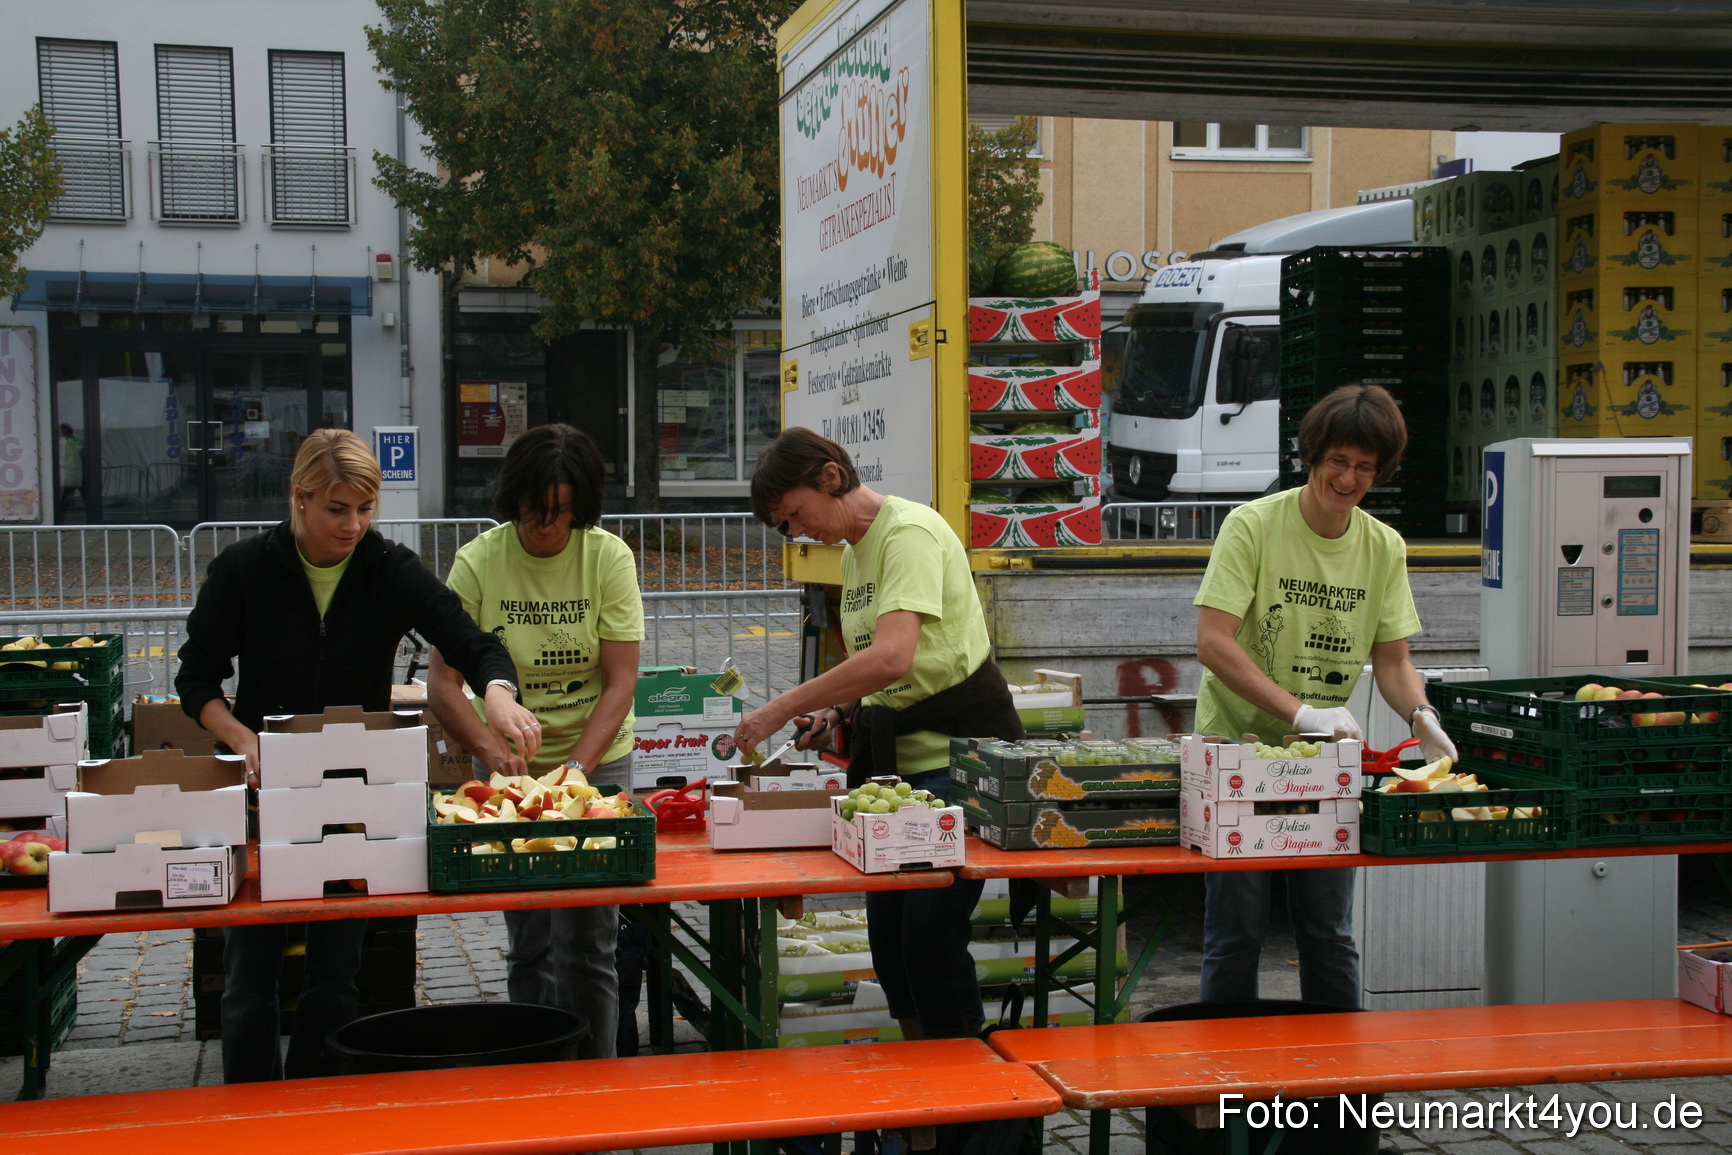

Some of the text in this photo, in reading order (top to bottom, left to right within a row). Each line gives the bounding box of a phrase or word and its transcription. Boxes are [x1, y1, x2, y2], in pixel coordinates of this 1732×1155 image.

[886, 252, 908, 285] Weine
[1155, 266, 1202, 288] BOCK
[808, 350, 892, 396] Festservice Getränkemärkte
[862, 408, 886, 442] 23456
[383, 435, 410, 444] HIER
[391, 446, 405, 467] P
[382, 470, 414, 479] SCHEINE
[1485, 470, 1499, 530] P
[1278, 577, 1367, 601] NEUMARKTER
[500, 599, 591, 613] NEUMARKTER
[1284, 591, 1357, 613] STADTLAUF
[507, 612, 586, 626] STADTLAUF
[648, 692, 690, 703] alegra
[1266, 760, 1313, 778] Delizie
[1255, 776, 1325, 800] di Stagione
[1265, 816, 1312, 834] Delizie
[1254, 833, 1324, 853] di Stagione
